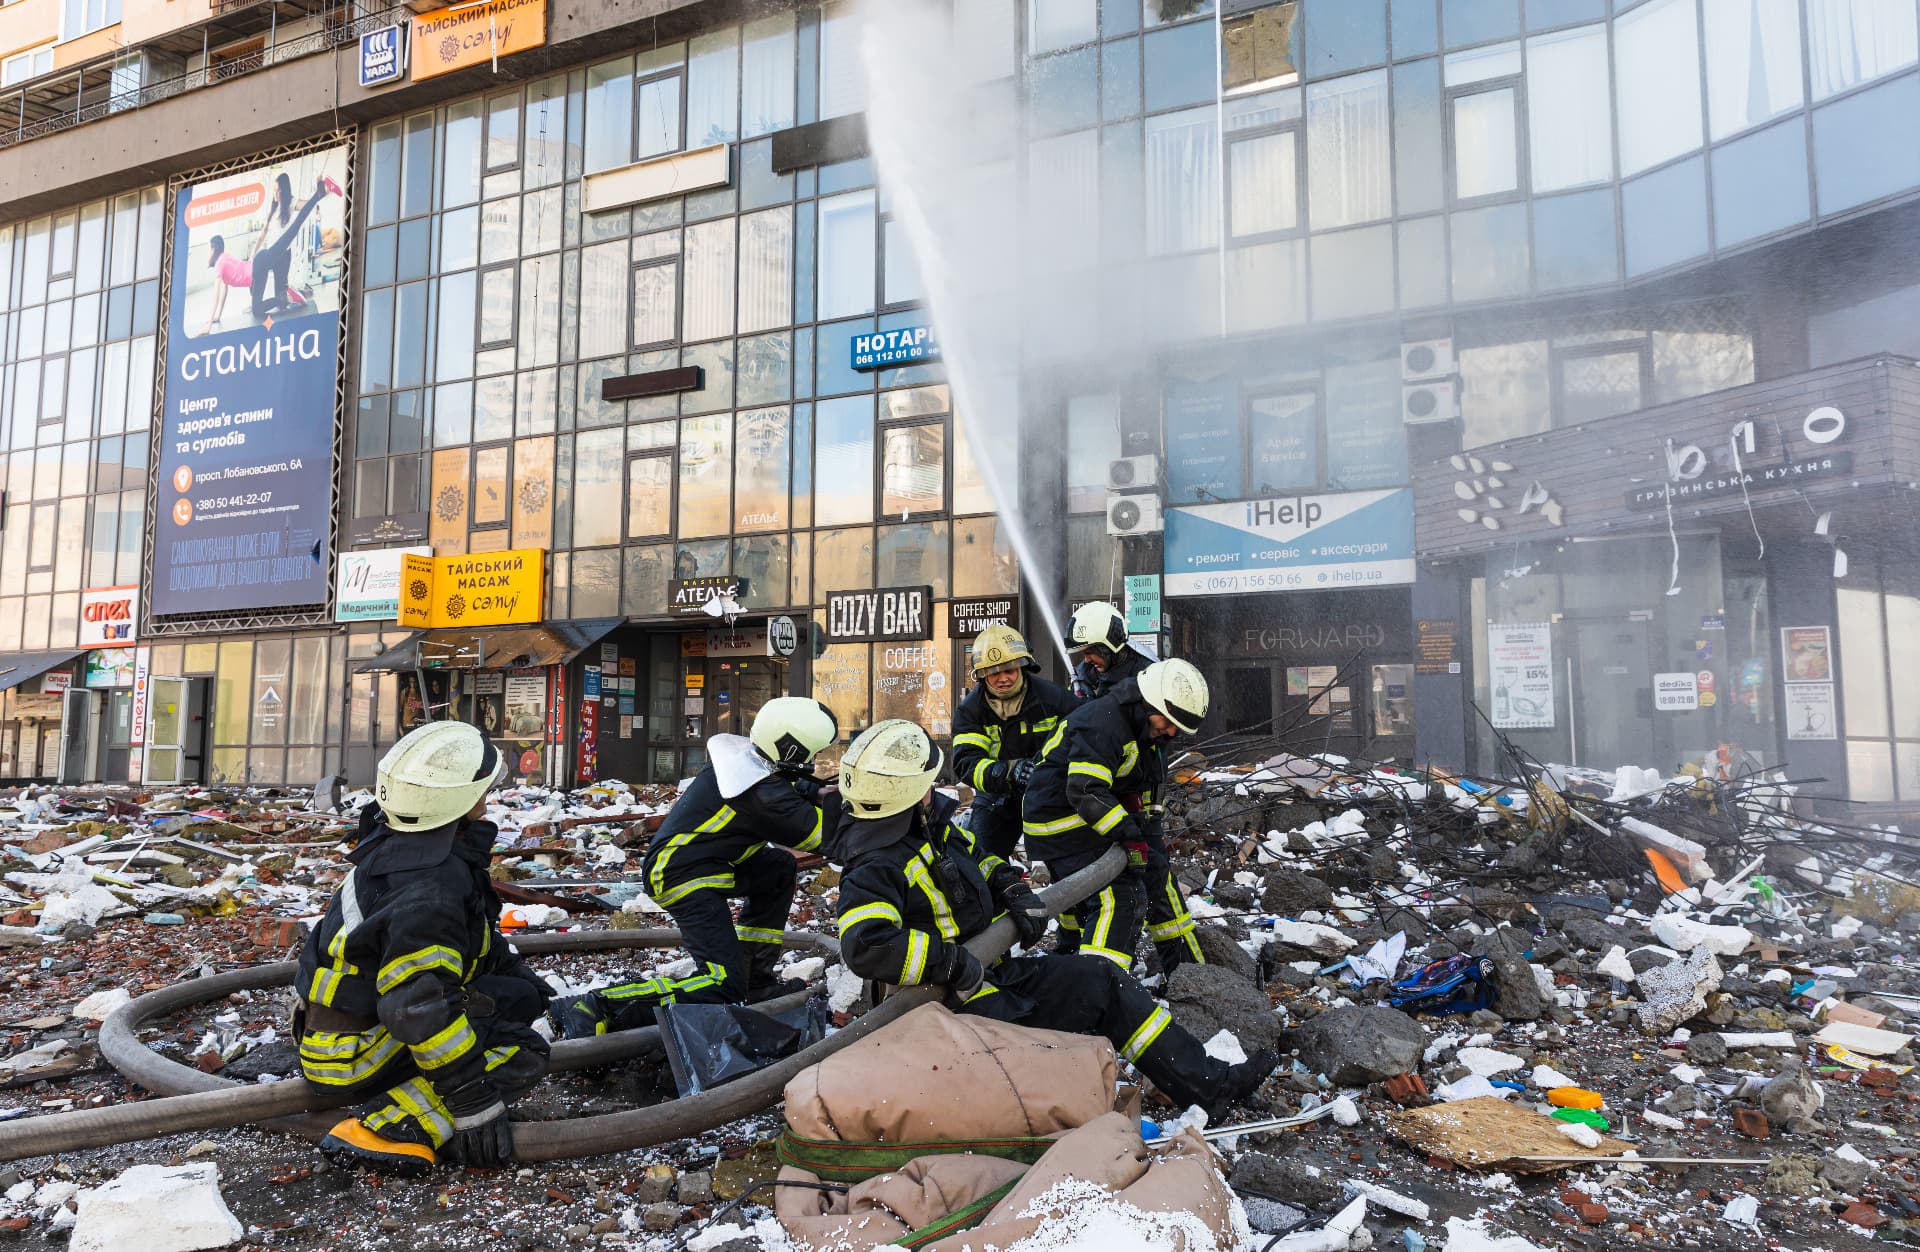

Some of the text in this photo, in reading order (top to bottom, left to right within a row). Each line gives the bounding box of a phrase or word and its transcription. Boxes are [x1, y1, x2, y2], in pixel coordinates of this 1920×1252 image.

[417, 6, 485, 37] ТАЙСЬКИЙ
[365, 63, 393, 79] YARA
[876, 351, 893, 362] 112
[896, 349, 907, 359] 01
[910, 347, 922, 357] 00
[179, 397, 218, 414] Центр
[177, 407, 273, 435] здоров'я спини
[176, 431, 246, 454] та суглобів
[195, 471, 223, 484] просп.
[290, 458, 303, 470] 6А
[1636, 459, 1833, 503] ГРУЗИНСЬКА КУХНЯ
[195, 491, 272, 511] +380 50 441-22-07
[1246, 497, 1322, 529] iHelp
[1195, 542, 1388, 566] ремонт сервіс аксесуари
[407, 565, 432, 574] МАСАЖ
[447, 557, 523, 575] ТАЙСЬКИЙ
[458, 575, 510, 589] МАСАЖ
[1207, 569, 1383, 590] (067) 156 50 66 ihelp.ua
[1133, 592, 1158, 601] STUDIO
[83, 599, 131, 622] anex
[341, 601, 390, 614] Медичний
[830, 594, 878, 637] COZY
[882, 591, 922, 635] BAR
[953, 601, 1011, 617] COFFEE SHOP
[102, 623, 132, 639] tour
[959, 619, 966, 632] &
[1246, 624, 1385, 650] FORWARD
[885, 647, 937, 669] COFFEE
[1526, 669, 1549, 679] 15%
[845, 773, 852, 789] 8
[380, 785, 387, 801] 8
